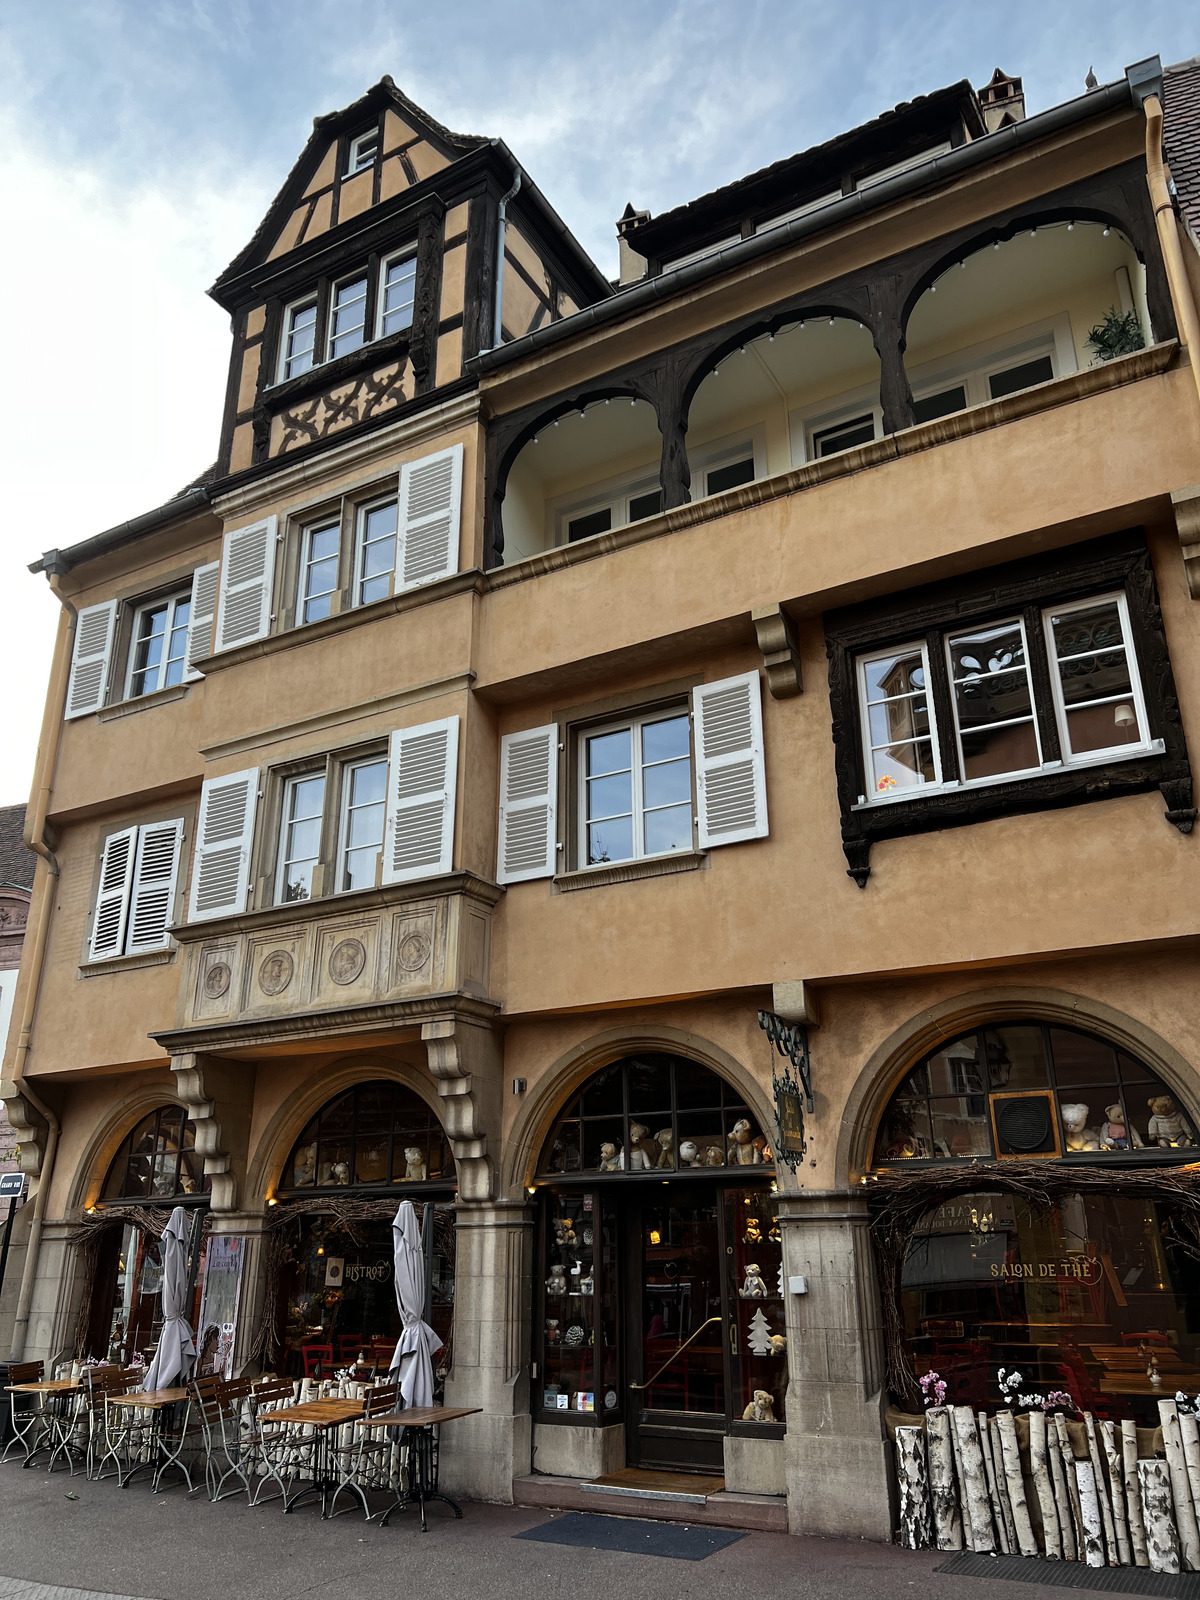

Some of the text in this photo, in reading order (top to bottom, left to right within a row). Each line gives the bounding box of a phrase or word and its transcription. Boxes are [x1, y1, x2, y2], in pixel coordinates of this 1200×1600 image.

[345, 1266, 385, 1281] BISTROT
[990, 1263, 1034, 1278] SALON
[1039, 1263, 1057, 1277] DE
